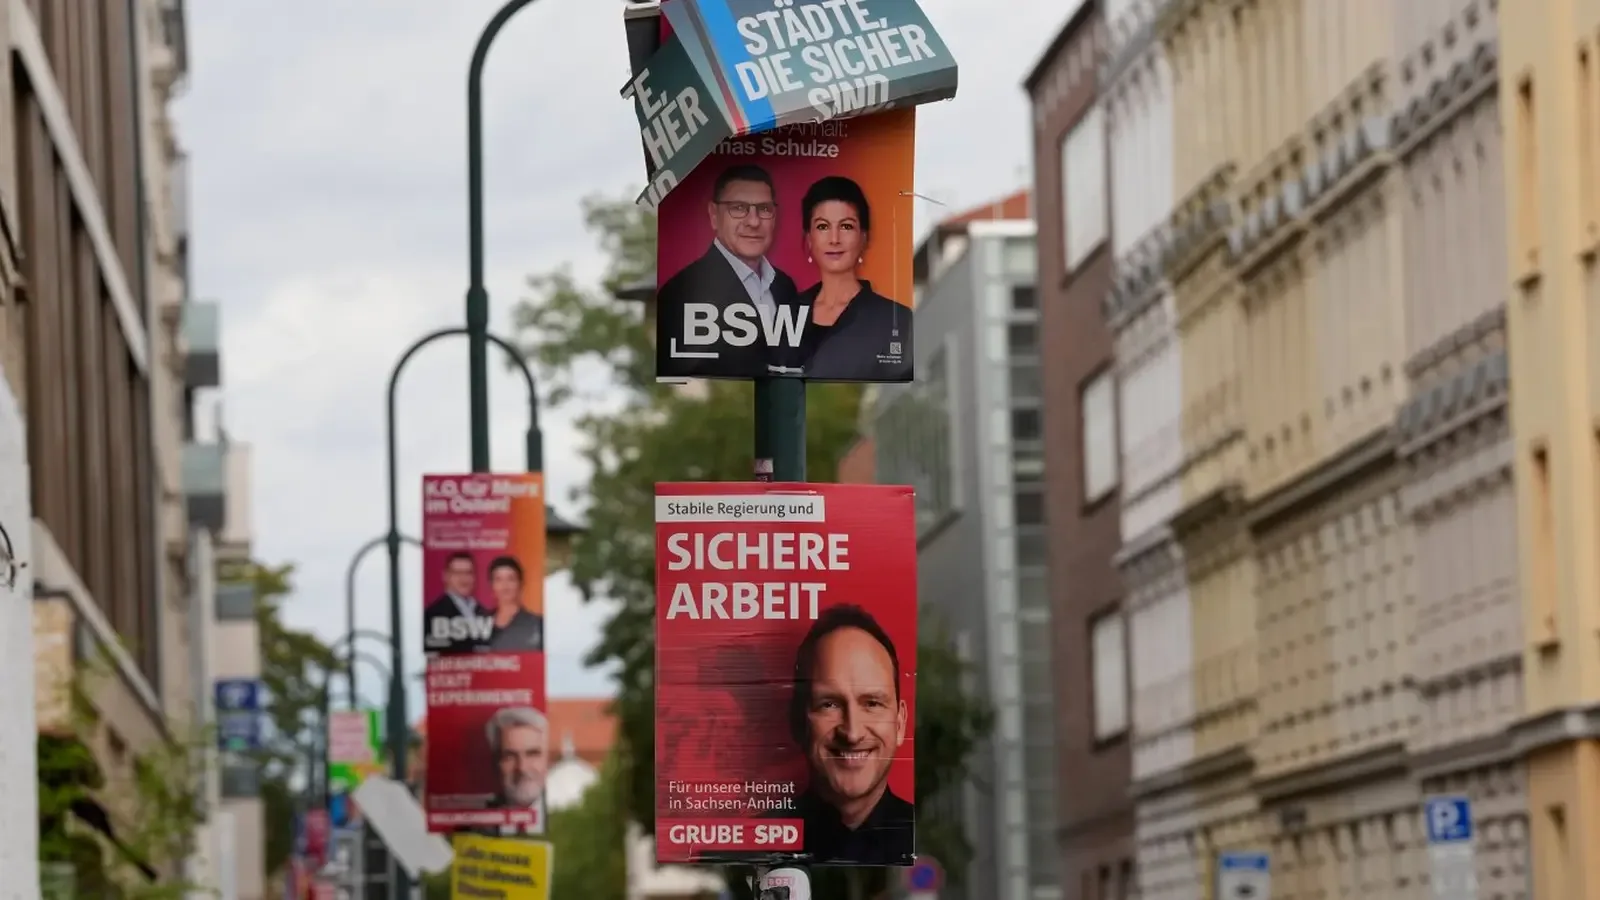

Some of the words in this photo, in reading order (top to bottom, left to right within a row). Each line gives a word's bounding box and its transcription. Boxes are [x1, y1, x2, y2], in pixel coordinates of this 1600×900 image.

[736, 0, 888, 55] STÄDTE,
[734, 52, 804, 101] DIE
[801, 24, 936, 84] SICHER
[761, 137, 839, 158] Schulze
[683, 303, 810, 347] BSW
[667, 502, 714, 515] Stabile
[717, 502, 785, 517] Regierung
[789, 502, 814, 515] und
[667, 533, 850, 570] SICHERE
[666, 582, 827, 620] ARBEIT
[431, 616, 494, 640] BSW
[669, 781, 691, 793] Für
[695, 784, 741, 794] unsere
[744, 781, 795, 794] Heimat
[669, 797, 682, 809] in
[686, 797, 797, 810] Sachsen-Anhalt.
[669, 825, 744, 844] GRUBE
[754, 825, 799, 844] SPD
